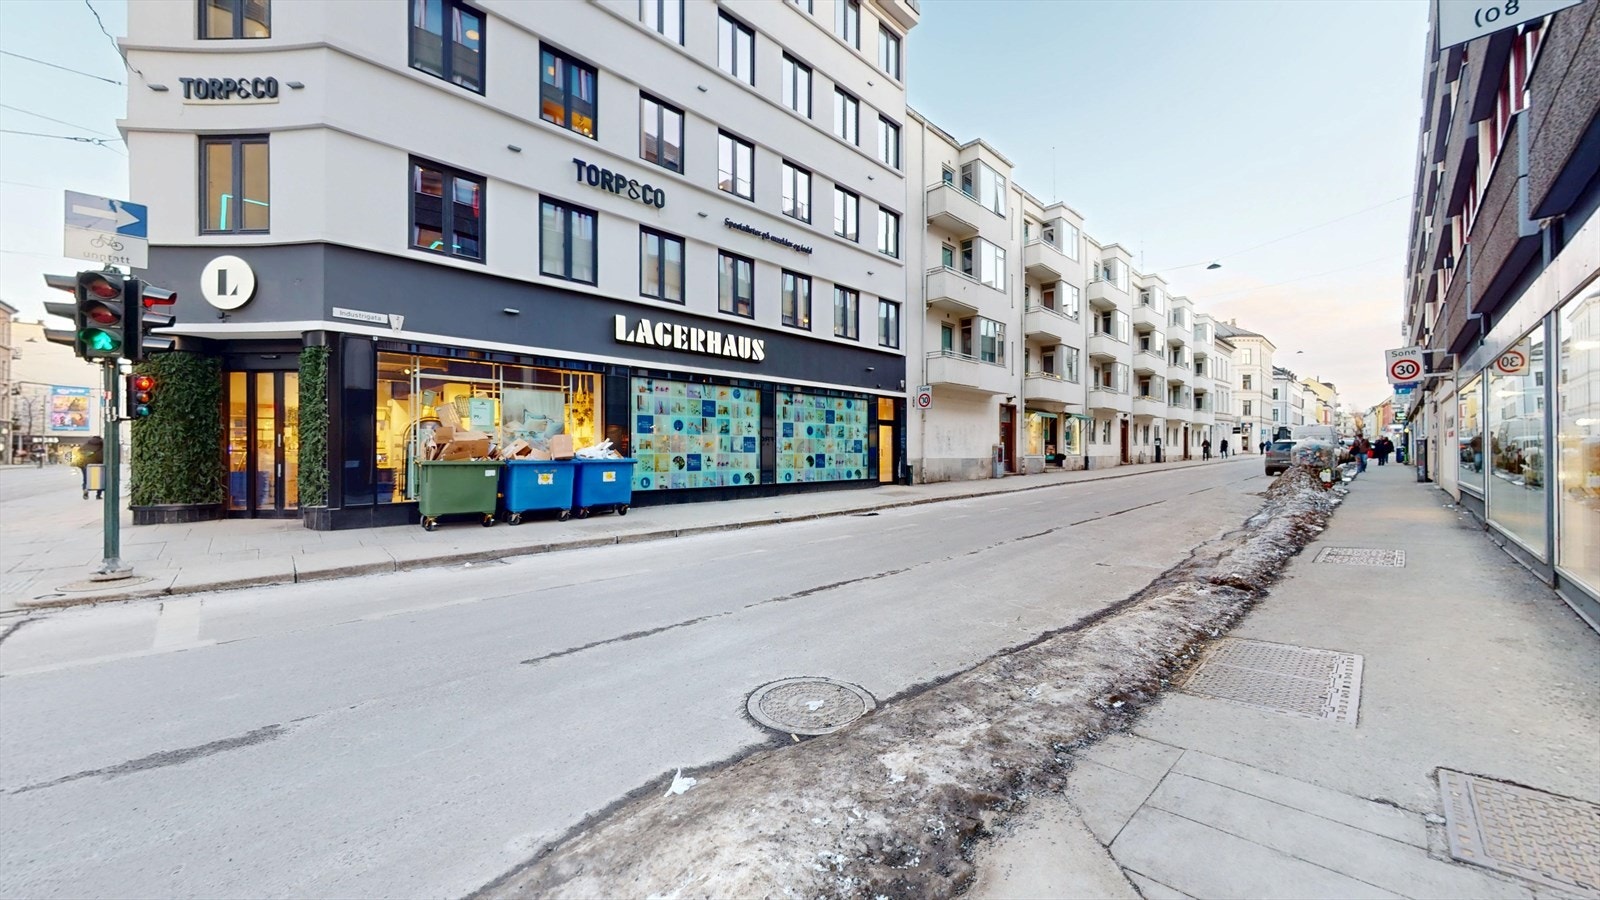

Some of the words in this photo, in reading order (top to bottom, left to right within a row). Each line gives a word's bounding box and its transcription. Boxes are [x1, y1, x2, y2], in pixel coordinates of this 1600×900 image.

[179, 76, 279, 99] TORP&CO
[573, 158, 666, 209] TORP&CO
[761, 231, 770, 240] på
[339, 310, 382, 321] Industrigata
[614, 313, 766, 362] LAGERHAUS
[1391, 350, 1417, 358] Sone
[1396, 364, 1415, 376] 30
